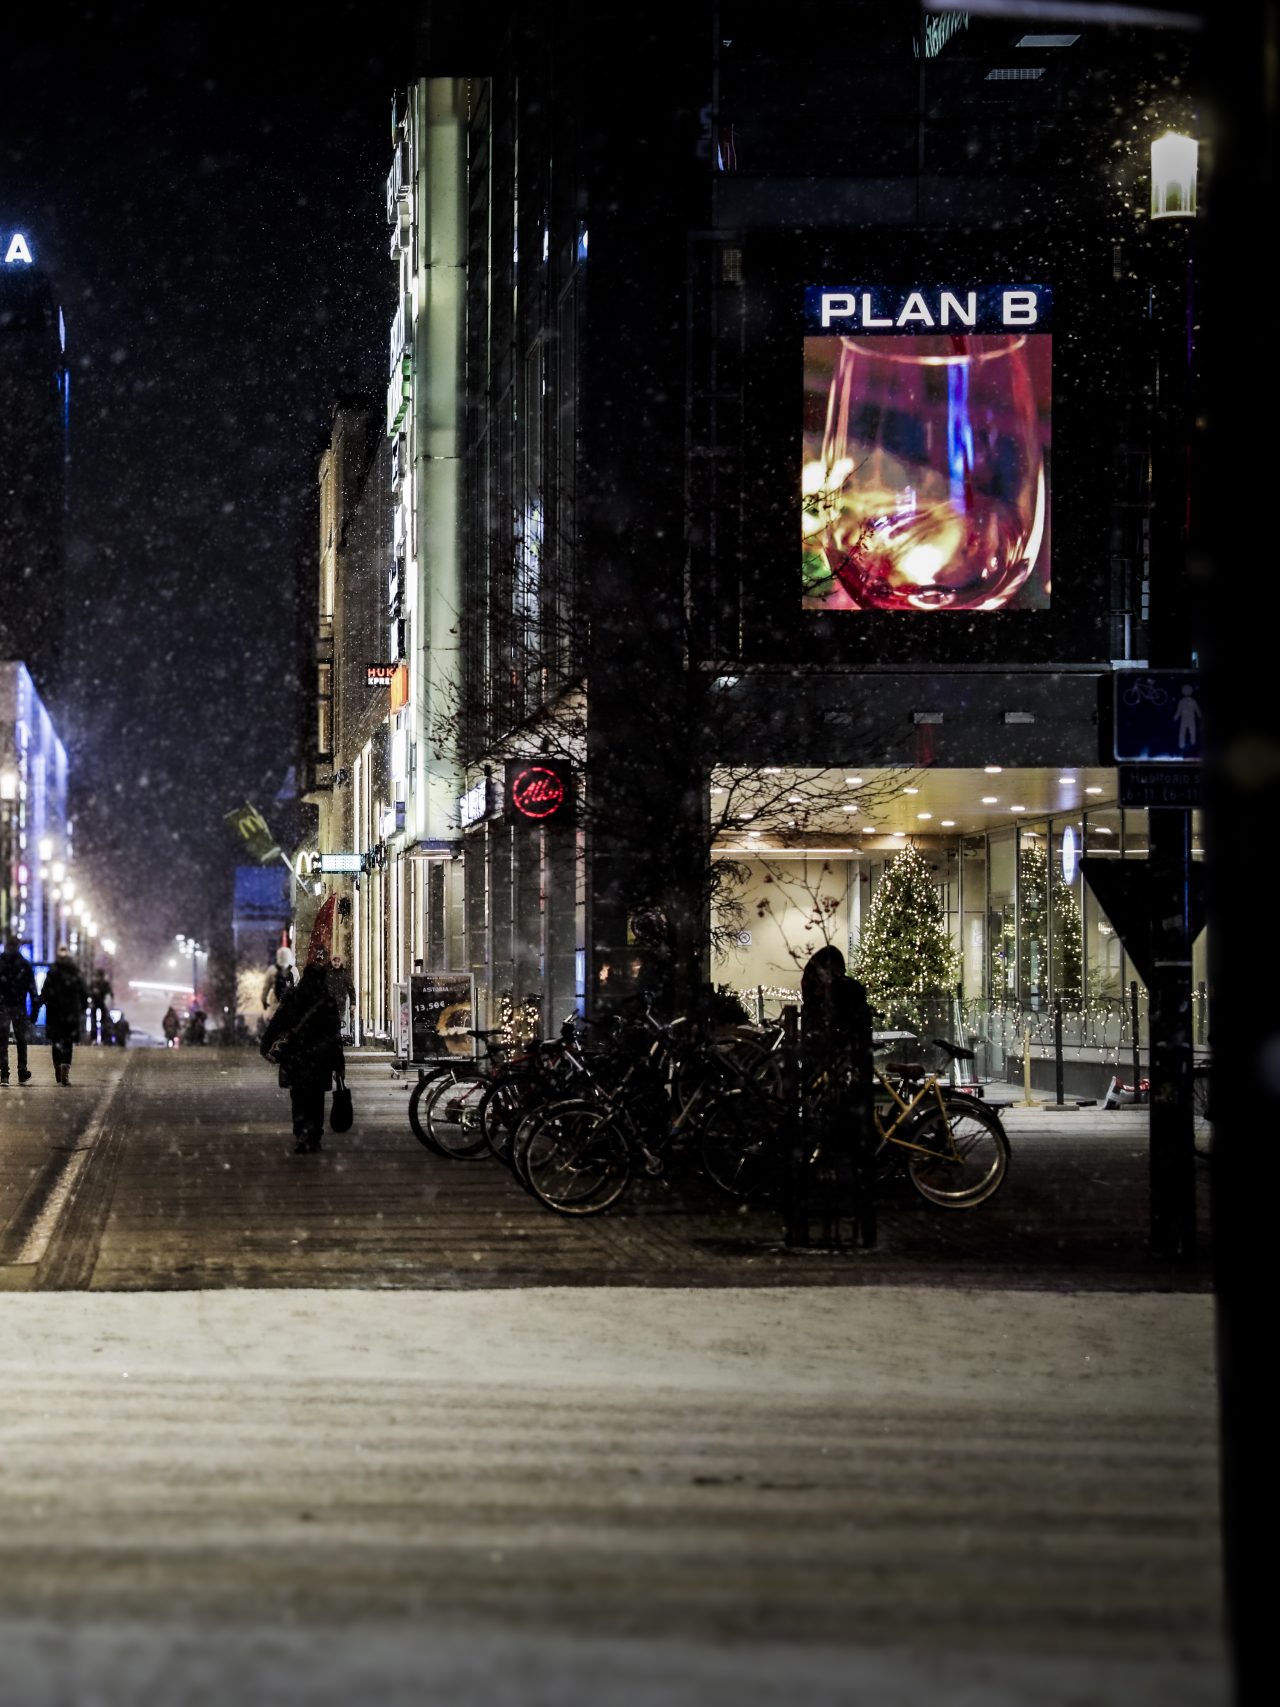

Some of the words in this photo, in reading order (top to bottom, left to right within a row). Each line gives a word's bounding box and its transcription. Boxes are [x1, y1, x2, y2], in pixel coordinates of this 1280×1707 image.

[821, 291, 978, 327] PLAN
[1002, 290, 1038, 325] B
[367, 667, 395, 678] HUK
